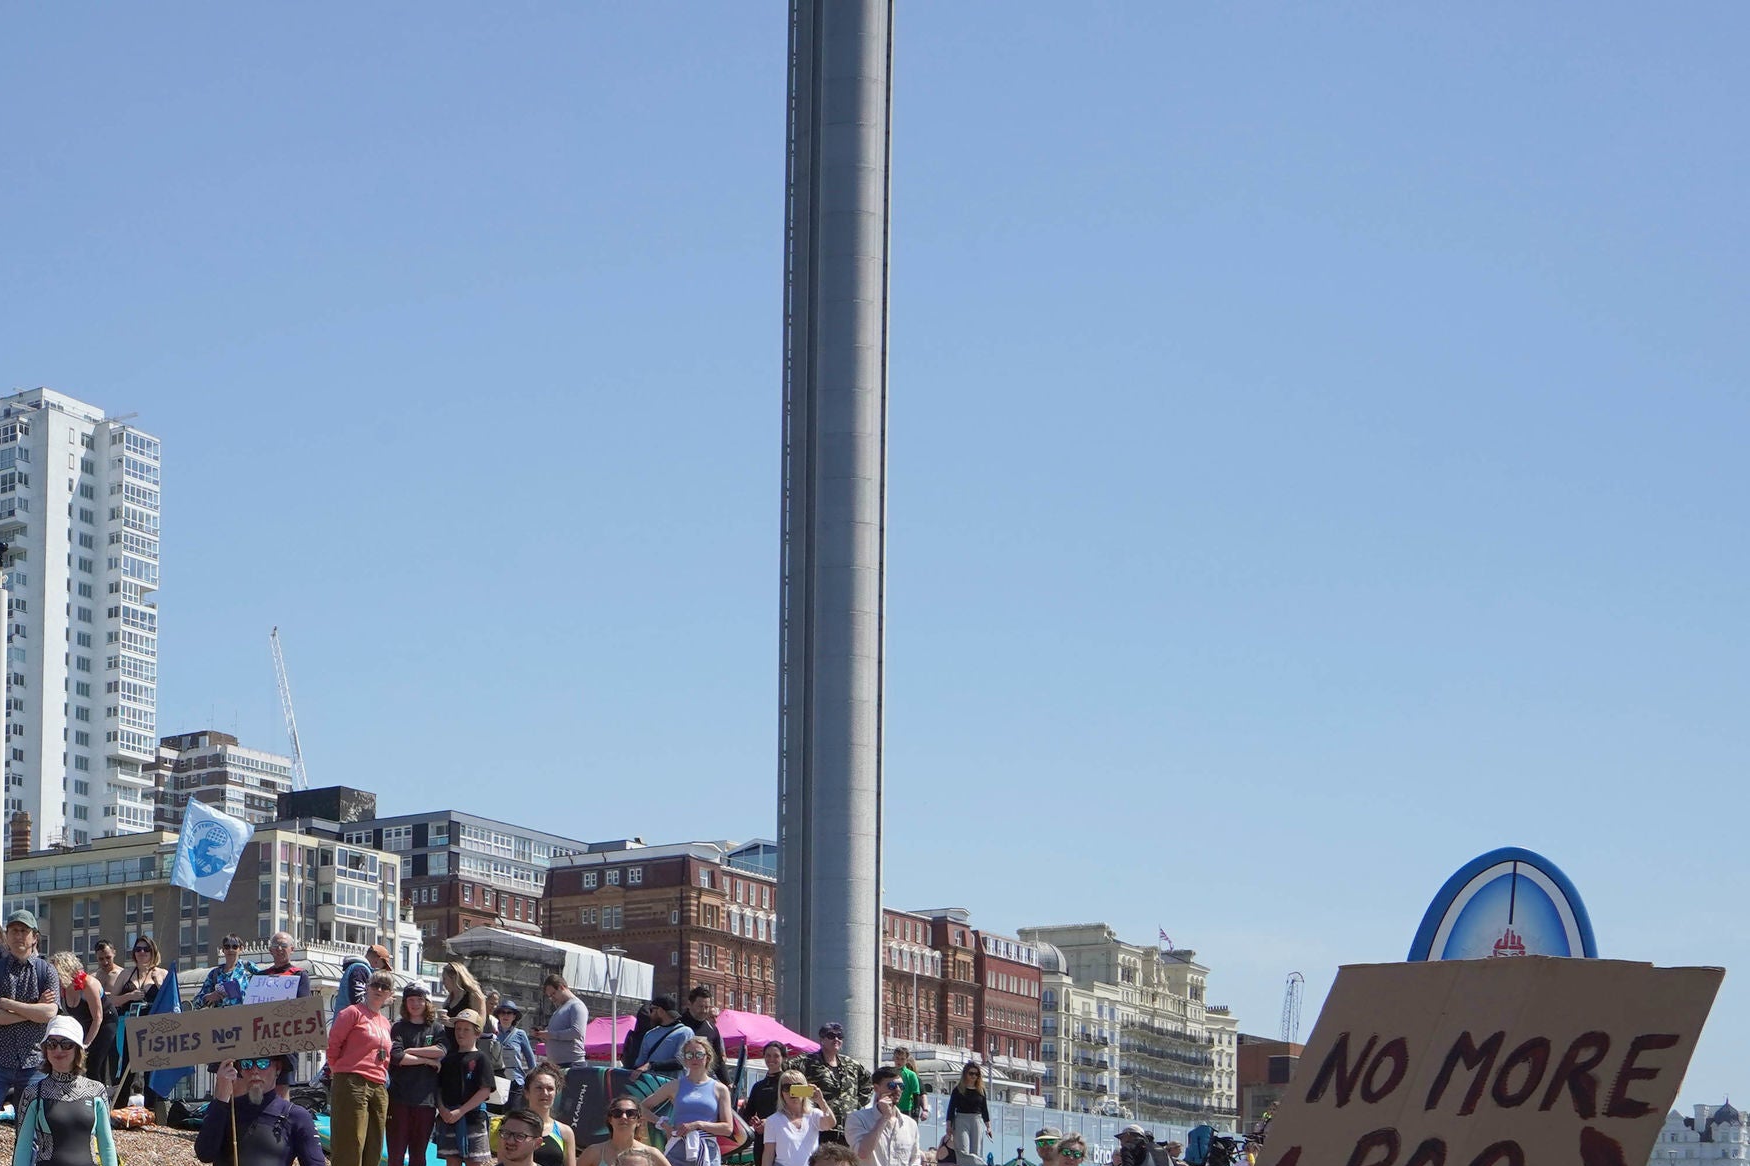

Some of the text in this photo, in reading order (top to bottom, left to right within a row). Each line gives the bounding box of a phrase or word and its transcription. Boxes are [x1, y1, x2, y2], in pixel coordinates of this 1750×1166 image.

[135, 1028, 201, 1058] FISHES
[252, 1010, 325, 1042] FAECES!
[1305, 1030, 1679, 1120] NO MORE
[575, 1084, 588, 1117] Hurley
